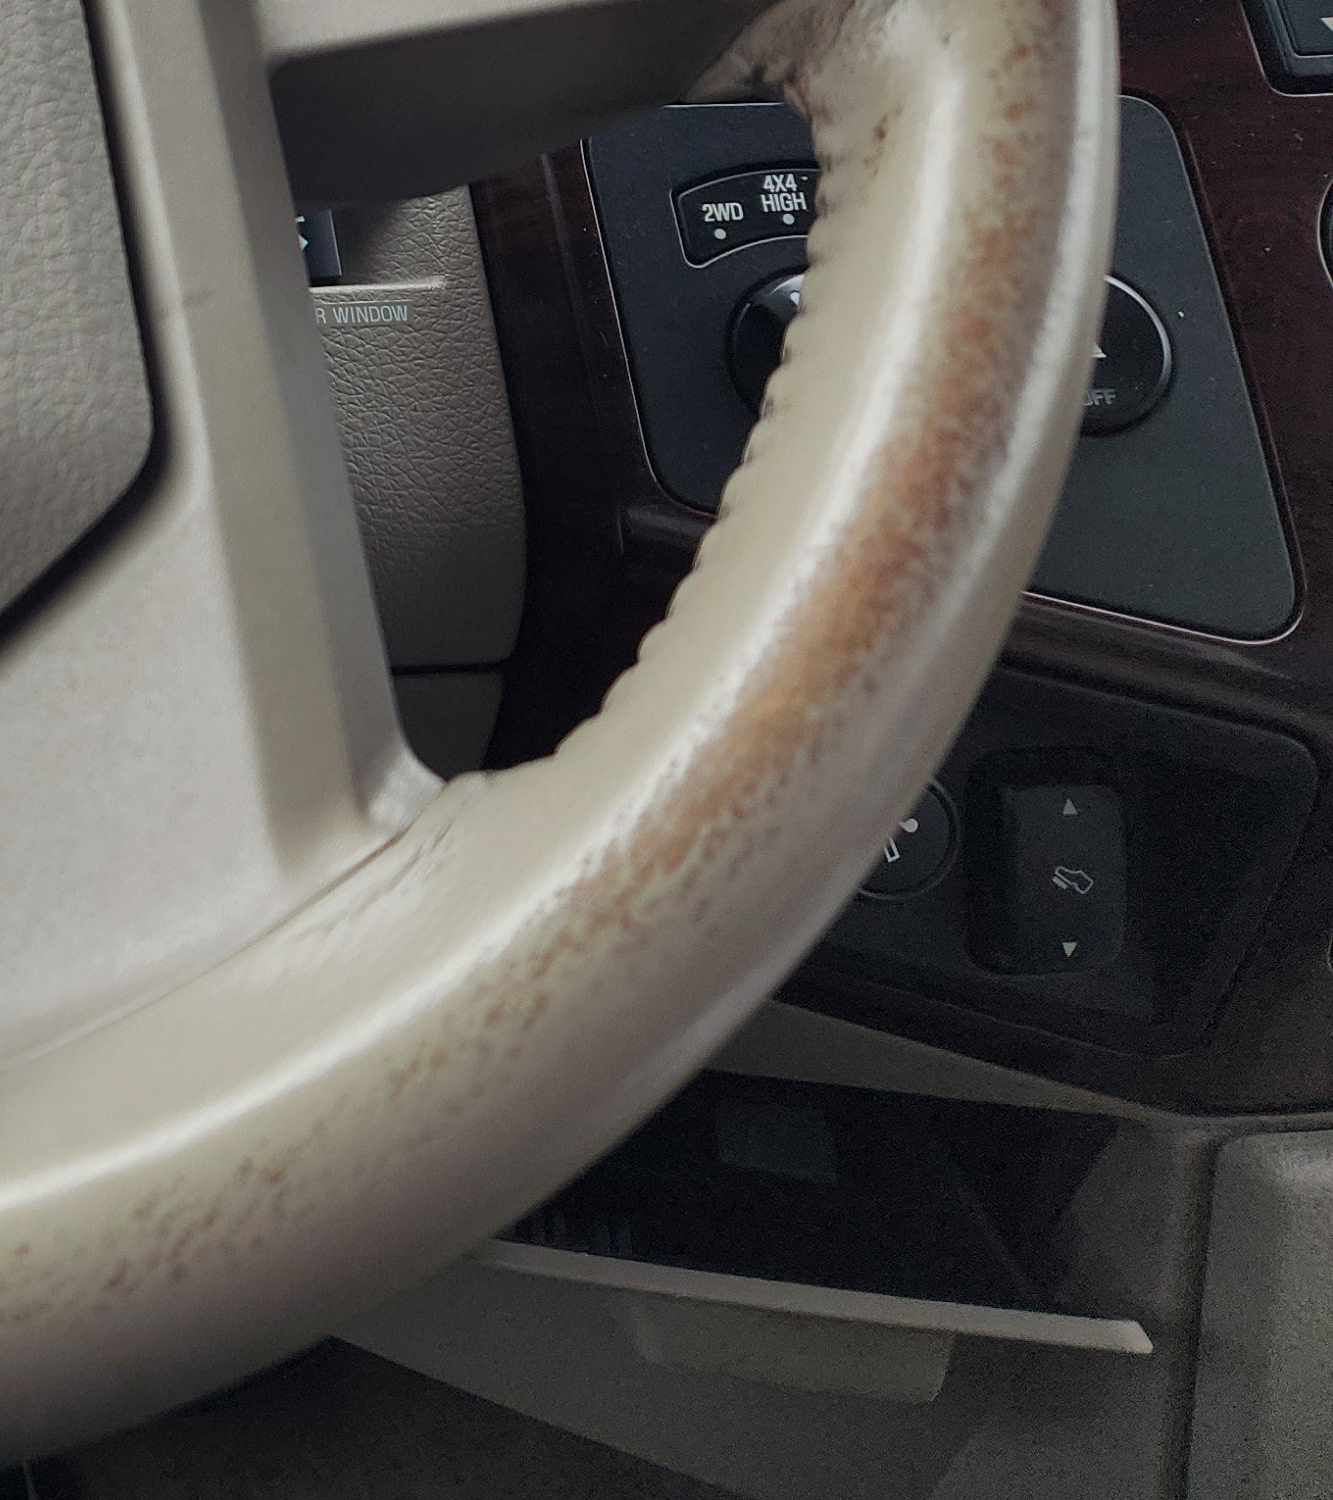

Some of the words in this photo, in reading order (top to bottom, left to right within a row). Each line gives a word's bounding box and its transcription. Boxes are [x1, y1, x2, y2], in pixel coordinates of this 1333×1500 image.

[764, 173, 797, 190] 4X4
[760, 193, 806, 211] HIGH
[702, 202, 742, 221] 2WD
[333, 305, 406, 323] WINDOW
